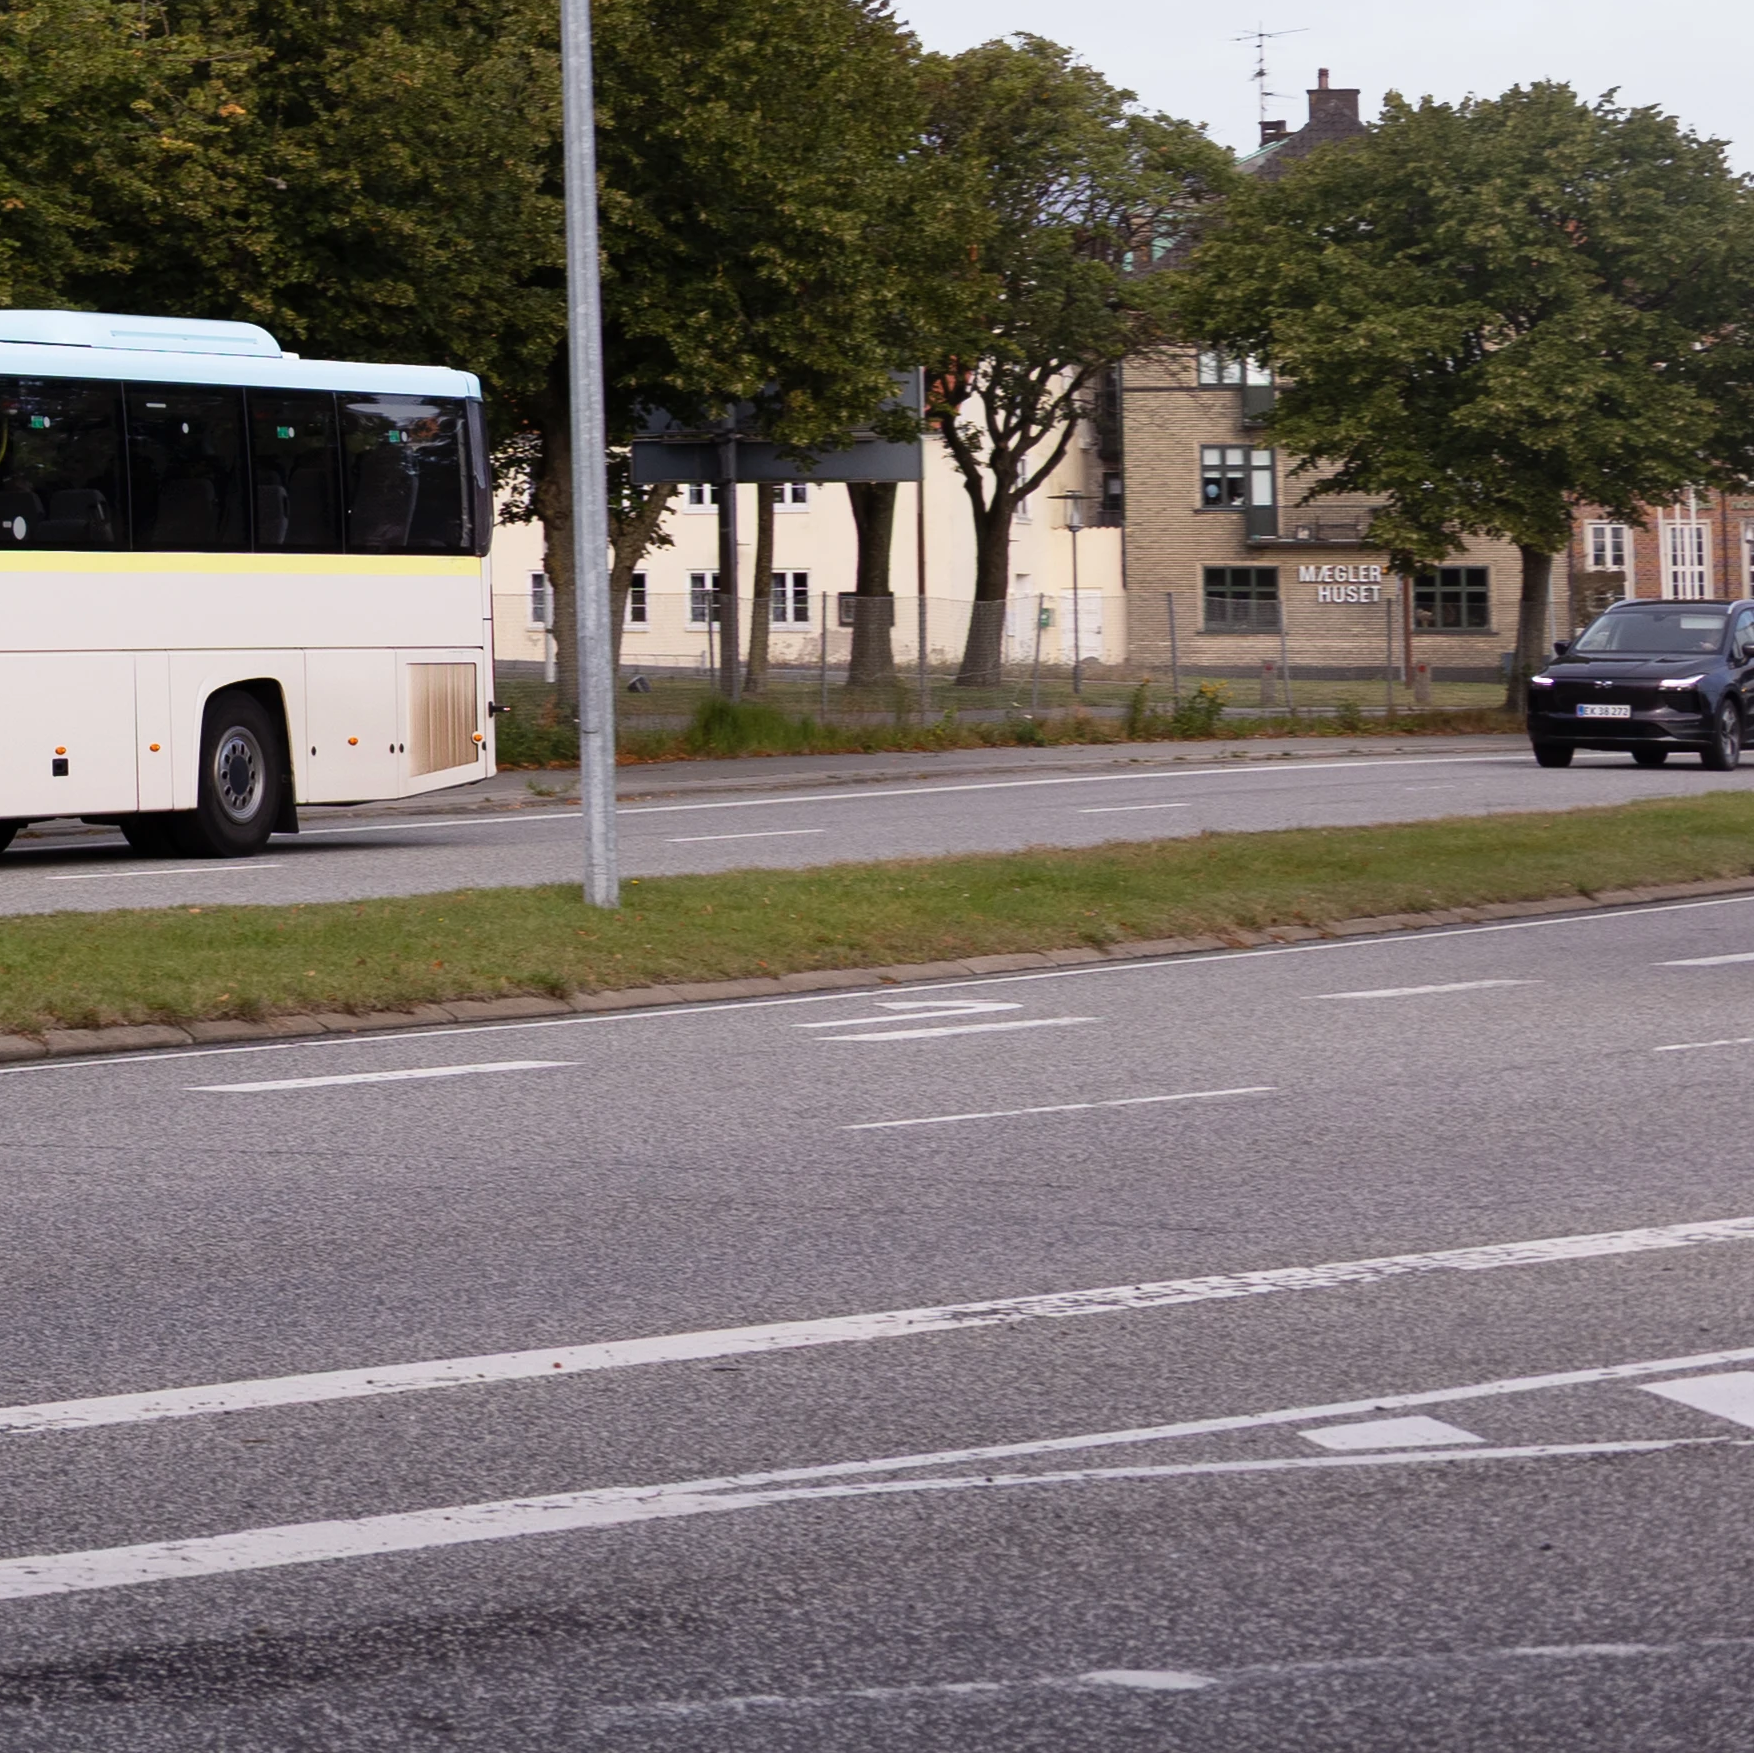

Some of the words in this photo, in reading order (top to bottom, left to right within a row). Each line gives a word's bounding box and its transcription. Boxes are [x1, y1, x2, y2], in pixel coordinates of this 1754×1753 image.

[1298, 565, 1382, 582] MÆGLER
[1318, 586, 1382, 603] HUSET
[1584, 706, 1596, 716] EK
[1612, 707, 1629, 716] 272
